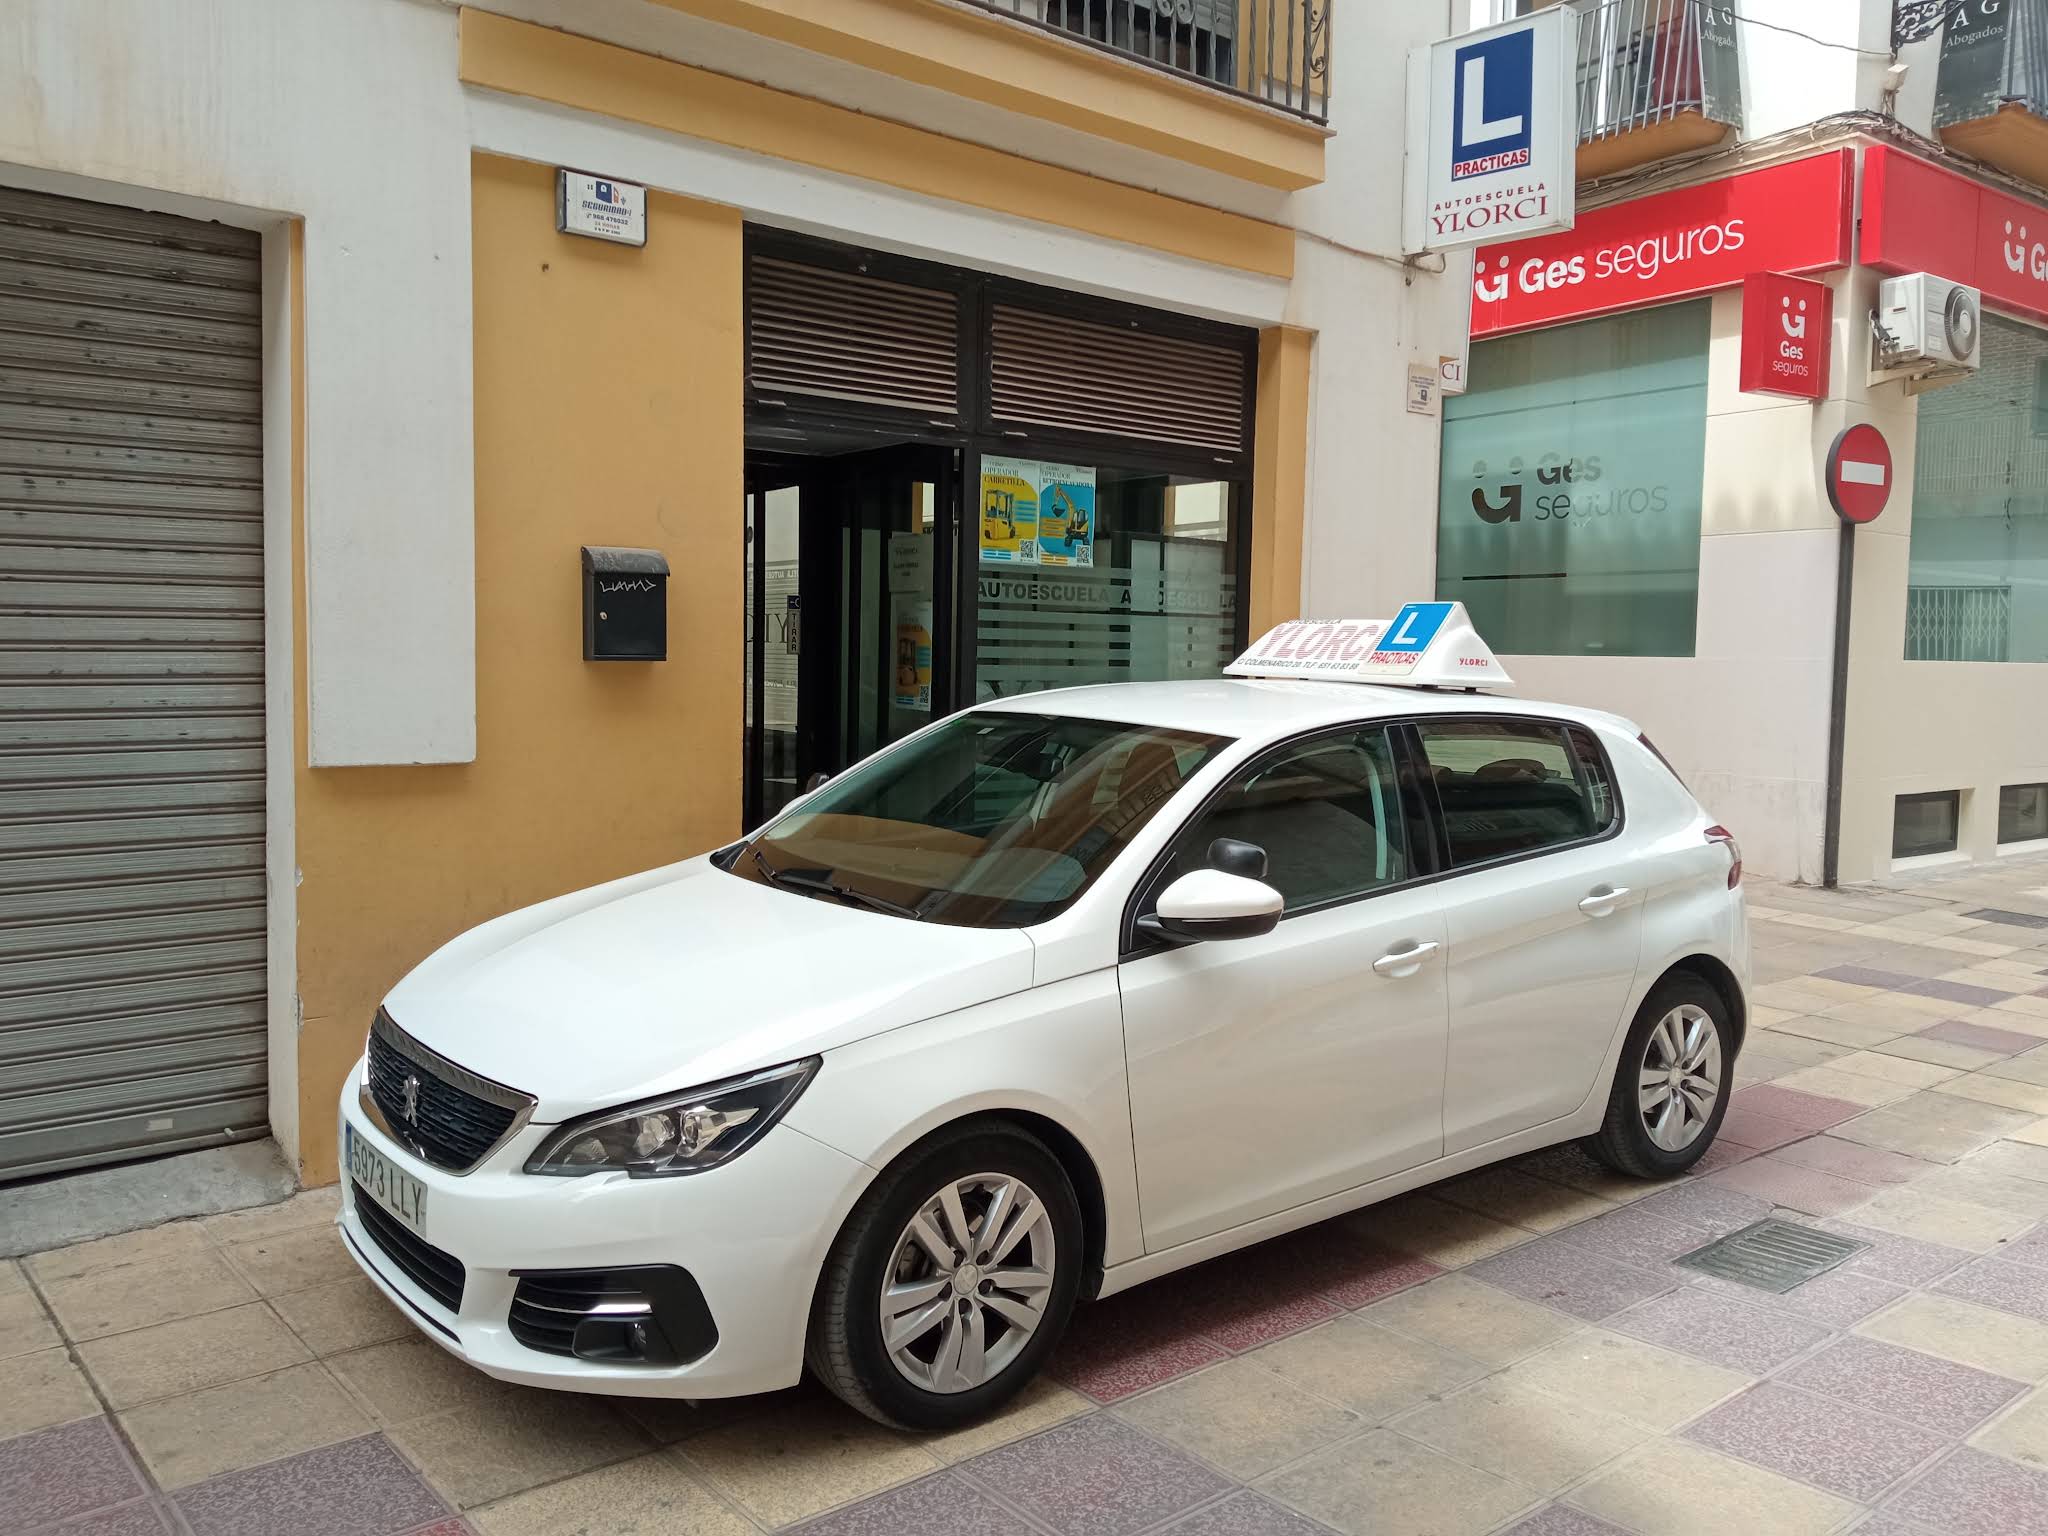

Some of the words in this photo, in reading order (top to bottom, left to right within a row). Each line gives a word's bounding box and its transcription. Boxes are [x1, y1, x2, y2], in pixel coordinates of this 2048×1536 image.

[1945, 25, 2004, 48] Abogados
[1461, 55, 1523, 148] L
[1454, 149, 1528, 178] PRACTICAS
[1434, 182, 1546, 212] AUTOESCUELA
[1431, 195, 1549, 235] YLORCI
[1518, 254, 1586, 294] Ges
[1594, 219, 1745, 281] seguros
[2030, 242, 2048, 282] G
[1780, 340, 1804, 361] Ges
[1772, 360, 1809, 377] seguros
[1536, 452, 1604, 486] Ges
[1534, 484, 1670, 526] seguros
[978, 581, 1111, 603] AUTOESCUELA
[1257, 624, 1384, 661] YLORCI
[1390, 611, 1420, 645] L
[1369, 652, 1420, 665] PRACTICAS
[1459, 658, 1488, 667] YLORCI
[352, 1136, 385, 1198] 5973
[390, 1168, 421, 1225] LLY
